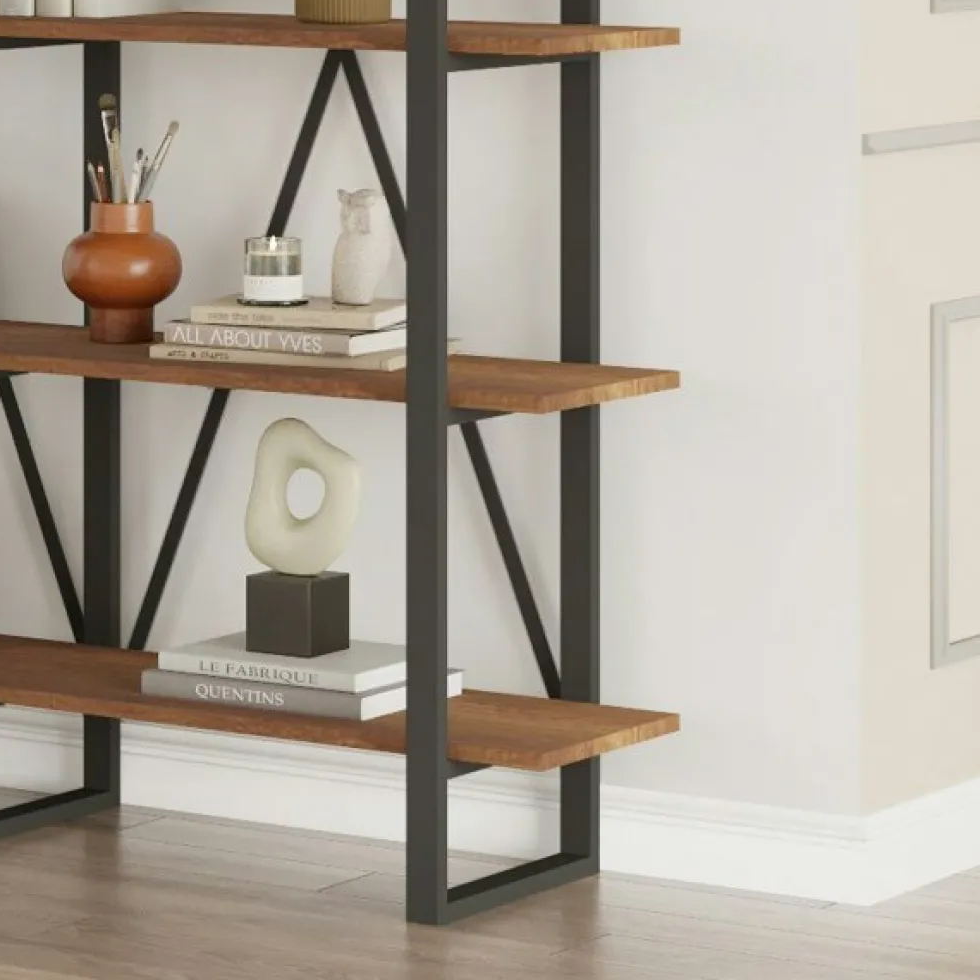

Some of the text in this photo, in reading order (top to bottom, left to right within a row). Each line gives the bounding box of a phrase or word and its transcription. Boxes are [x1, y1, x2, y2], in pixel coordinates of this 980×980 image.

[172, 329, 323, 354] ALL ABOUT YVES
[199, 659, 319, 686] LE FABRIQUE
[195, 683, 285, 707] QUENTINS
